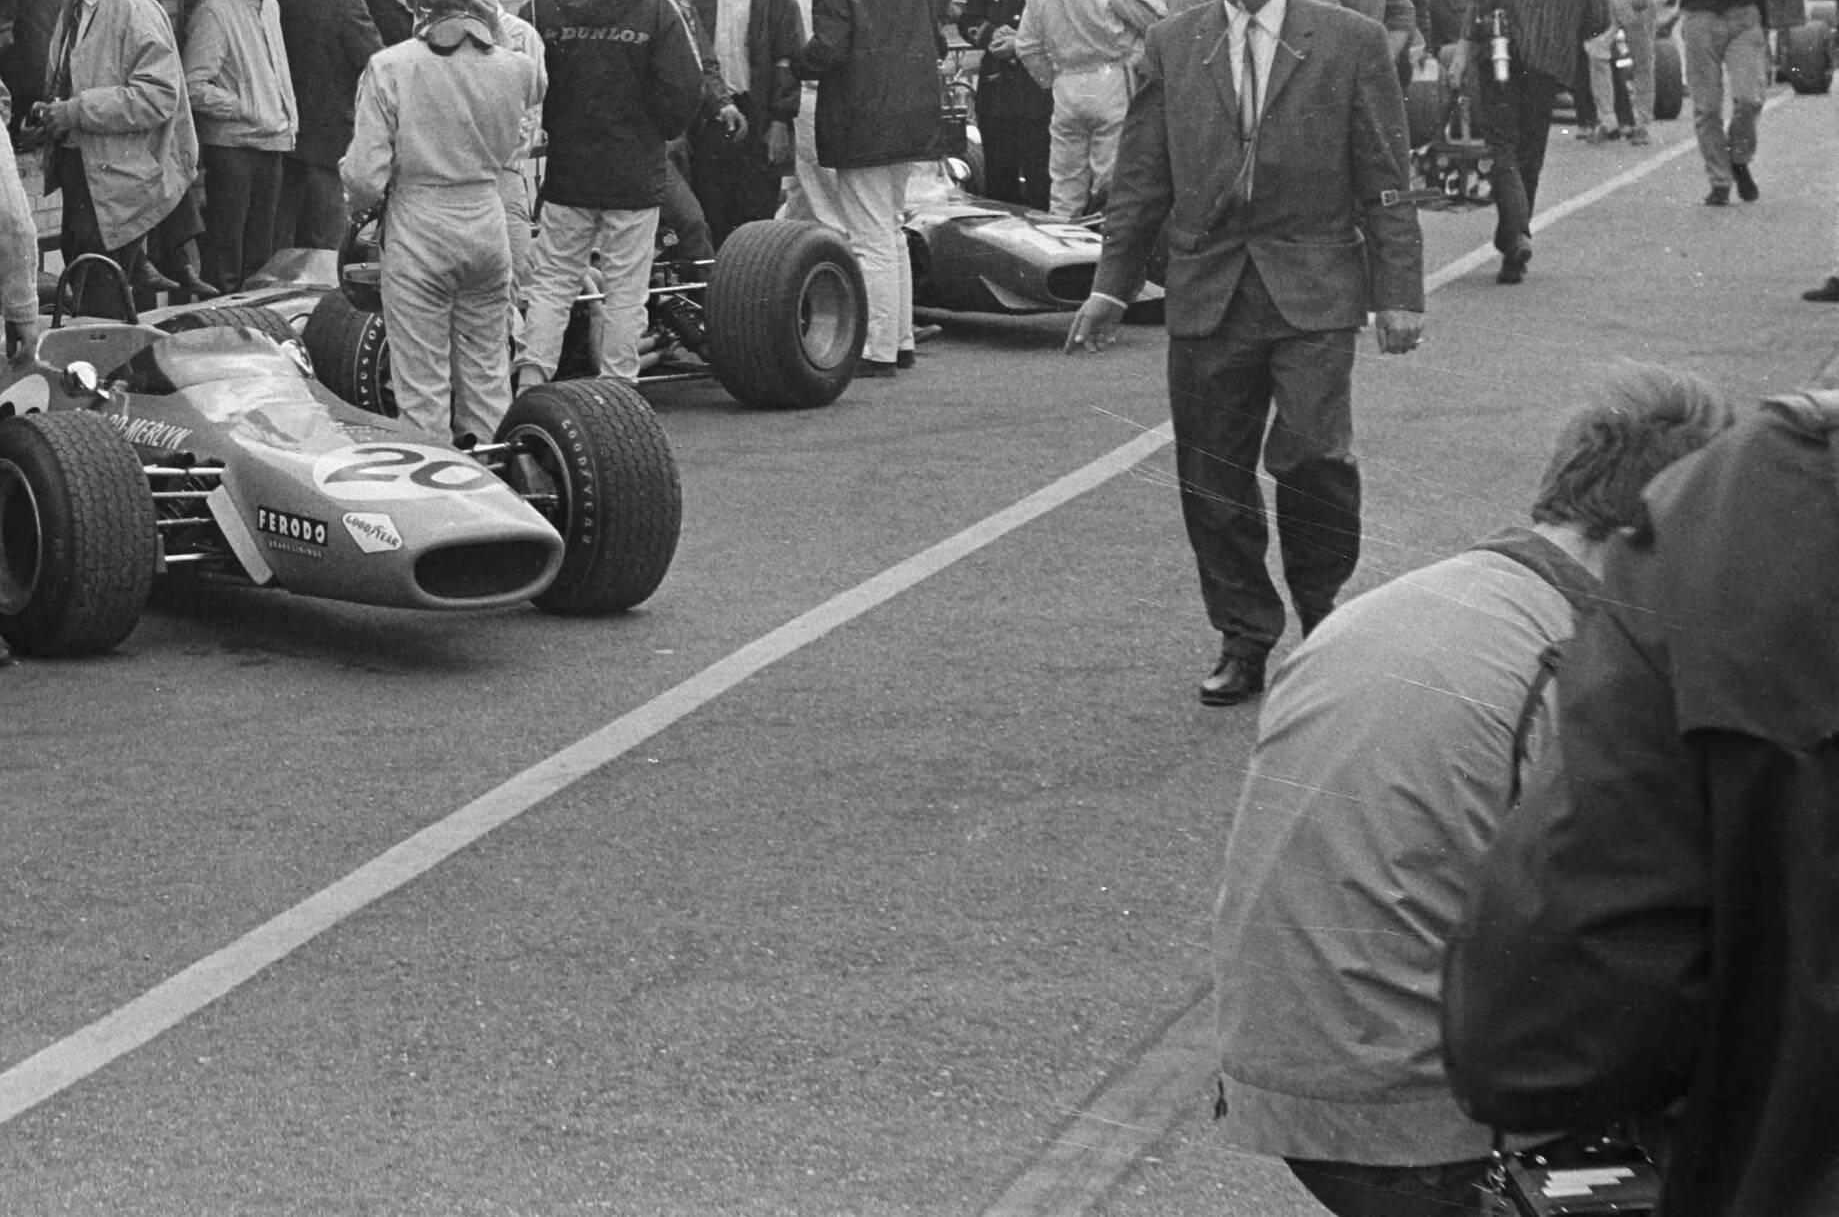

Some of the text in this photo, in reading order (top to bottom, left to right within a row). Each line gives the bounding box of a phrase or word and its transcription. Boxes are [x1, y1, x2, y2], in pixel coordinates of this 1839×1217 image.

[560, 26, 651, 45] DUNLOP
[323, 446, 503, 491] 20
[258, 508, 326, 545] FERODO
[345, 514, 400, 548] GOODYEAR
